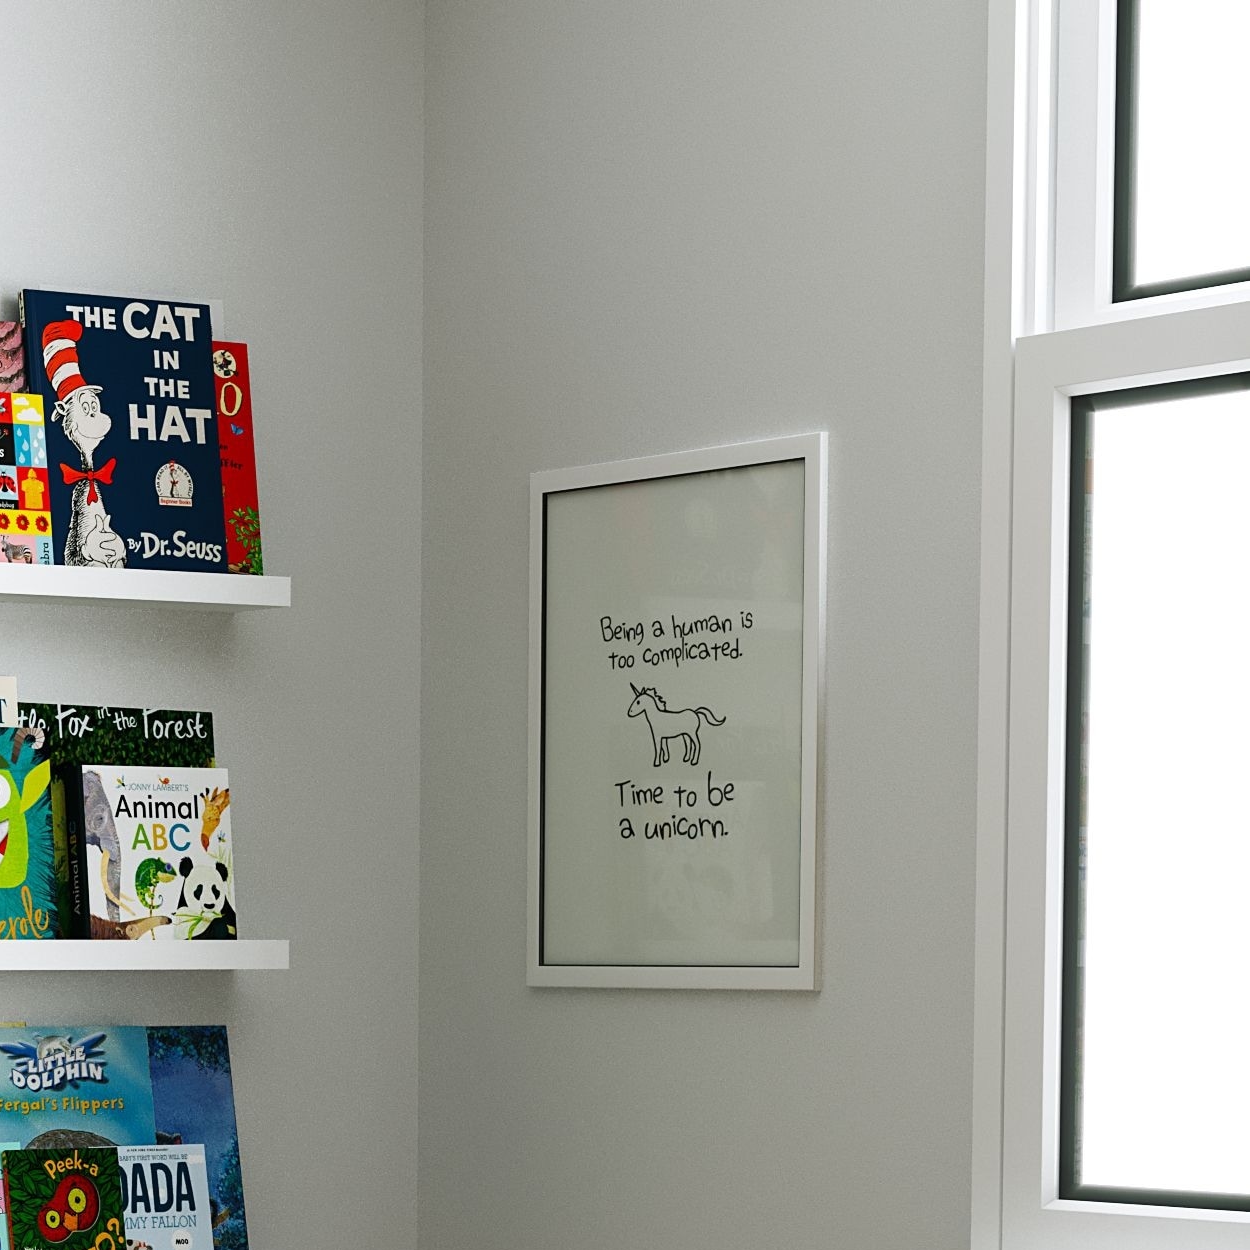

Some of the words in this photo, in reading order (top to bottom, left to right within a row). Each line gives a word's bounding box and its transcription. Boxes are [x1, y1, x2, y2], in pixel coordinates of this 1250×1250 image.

[66, 305, 117, 330] THE
[122, 302, 201, 342] CAT
[153, 350, 180, 370] IN
[144, 377, 190, 399] THE
[128, 403, 212, 445] HAT
[127, 538, 141, 553] By
[141, 532, 171, 559] Dr.
[172, 531, 222, 563] Seuss
[600, 616, 644, 646] Being
[651, 620, 665, 637] a
[671, 614, 732, 638] human
[740, 611, 753, 629] is
[608, 652, 635, 670] too
[642, 637, 743, 668] complicated.
[113, 713, 138, 732] the
[614, 779, 664, 807] Time
[673, 785, 697, 808] to
[707, 770, 735, 806] be
[115, 795, 199, 820] Animal
[131, 823, 191, 852] ABC
[619, 817, 635, 839] a
[644, 814, 729, 840] unicorn.
[27, 1045, 86, 1074] LITTLE
[12, 1063, 103, 1091] DOLPHIN
[62, 1097, 124, 1115] Flippers
[44, 1150, 99, 1180] Peek-a
[151, 1215, 197, 1229] FALLON
